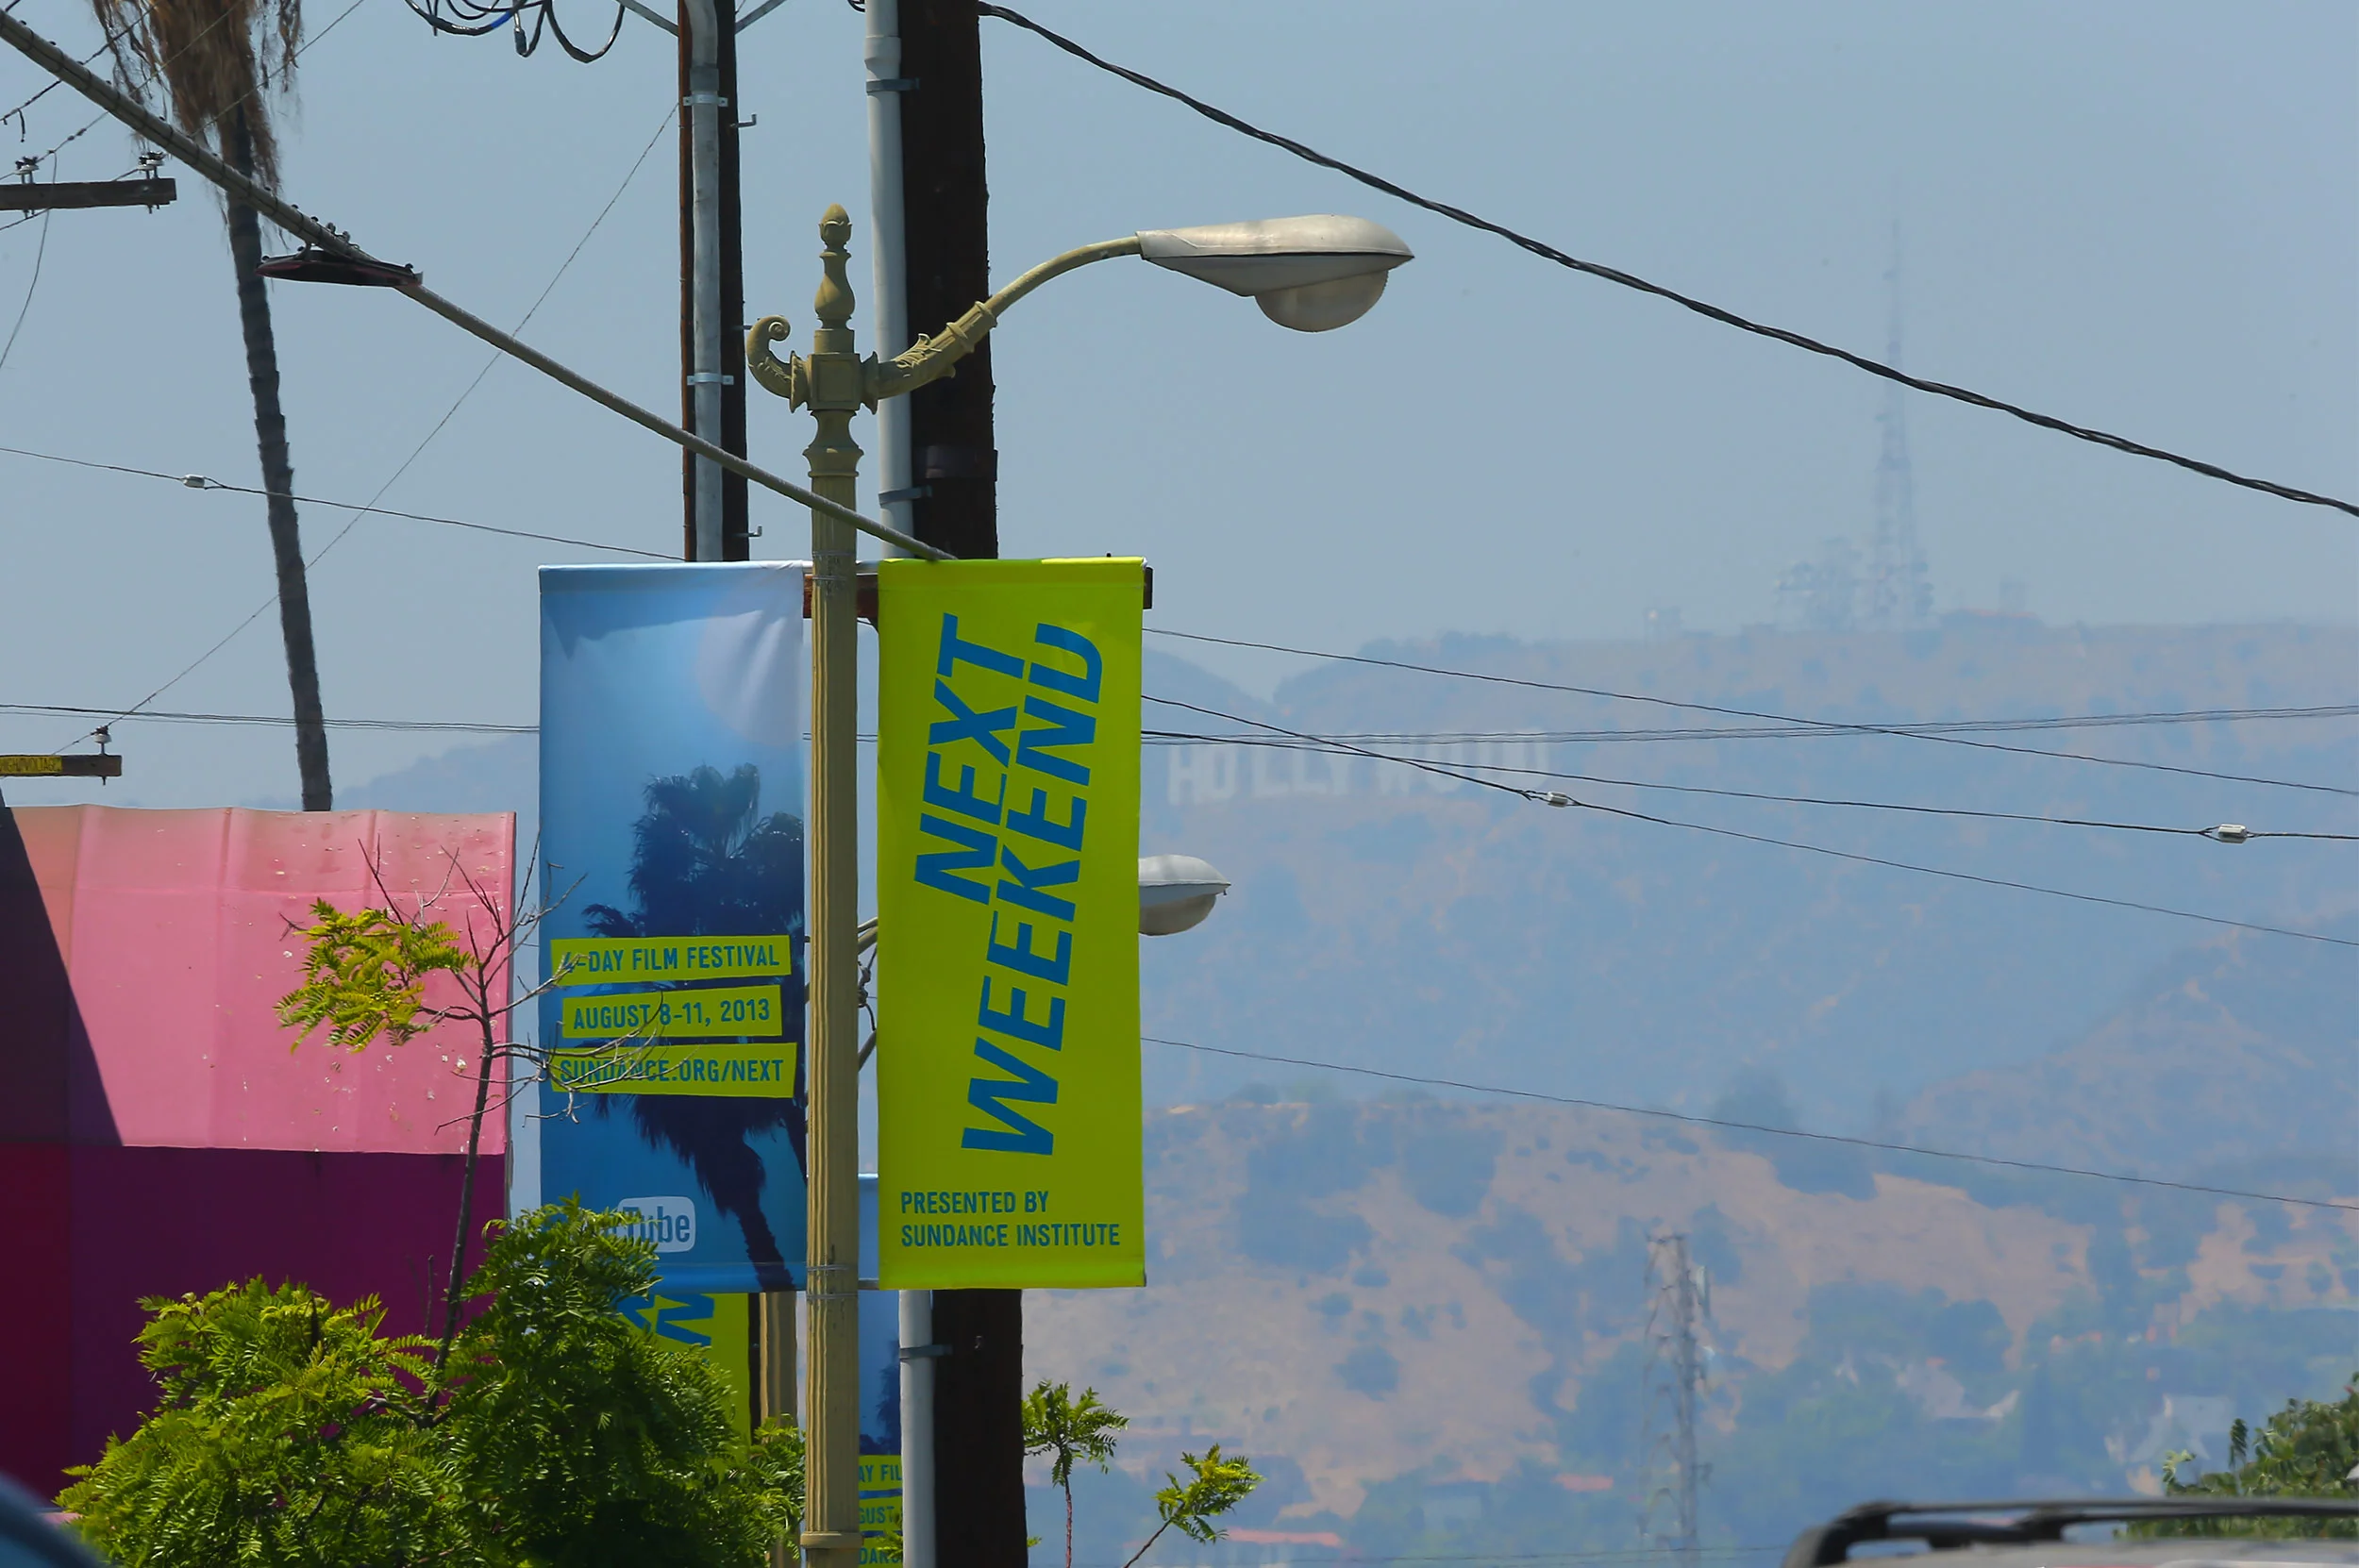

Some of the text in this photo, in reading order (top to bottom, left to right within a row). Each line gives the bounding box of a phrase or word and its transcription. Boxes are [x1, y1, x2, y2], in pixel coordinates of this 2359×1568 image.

[913, 612, 1025, 905] NEXT
[961, 622, 1103, 1156] WEEKEND
[632, 947, 678, 971] FILM
[687, 944, 779, 969] FESTIVAL
[574, 998, 770, 1029] AUGUST 8-11, 2013
[560, 1059, 784, 1083] SUNDANCE.ORG/NEXT
[901, 1191, 1049, 1214] PRESENTED BY
[605, 1206, 691, 1243] Tube
[901, 1223, 1120, 1246] SUNDANCE INSTITUTE
[880, 1464, 903, 1481] FIL
[859, 1506, 895, 1525] GUST
